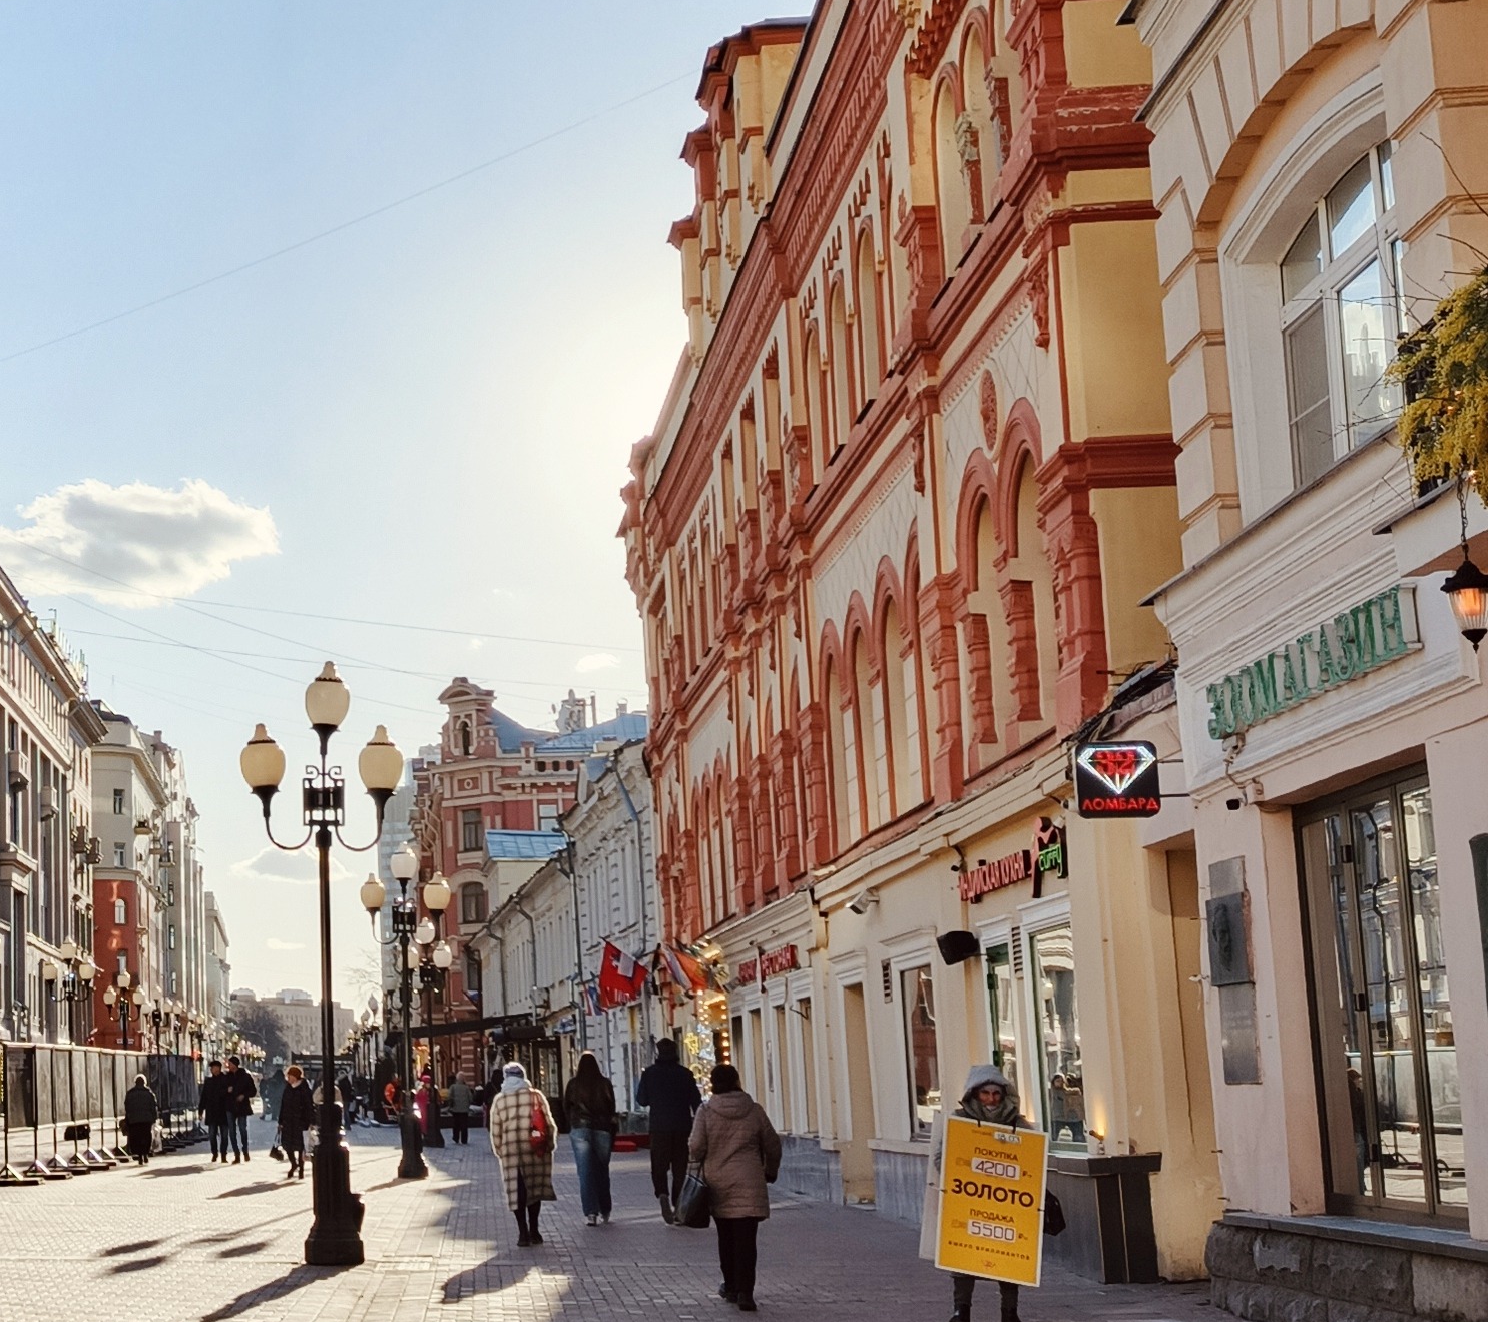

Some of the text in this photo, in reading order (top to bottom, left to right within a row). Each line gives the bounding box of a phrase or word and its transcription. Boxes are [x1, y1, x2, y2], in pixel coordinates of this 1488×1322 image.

[1206, 584, 1409, 739] ЗООМАГАЗИН
[1082, 797, 1159, 810] ЛОМБАРД
[974, 1147, 1018, 1161] ПОКУПКА
[975, 1160, 1016, 1178] 4200
[951, 1178, 1034, 1208] ЗОЛОТО
[969, 1208, 1015, 1223] ПРОДАЖА
[971, 1221, 1015, 1241] 5500
